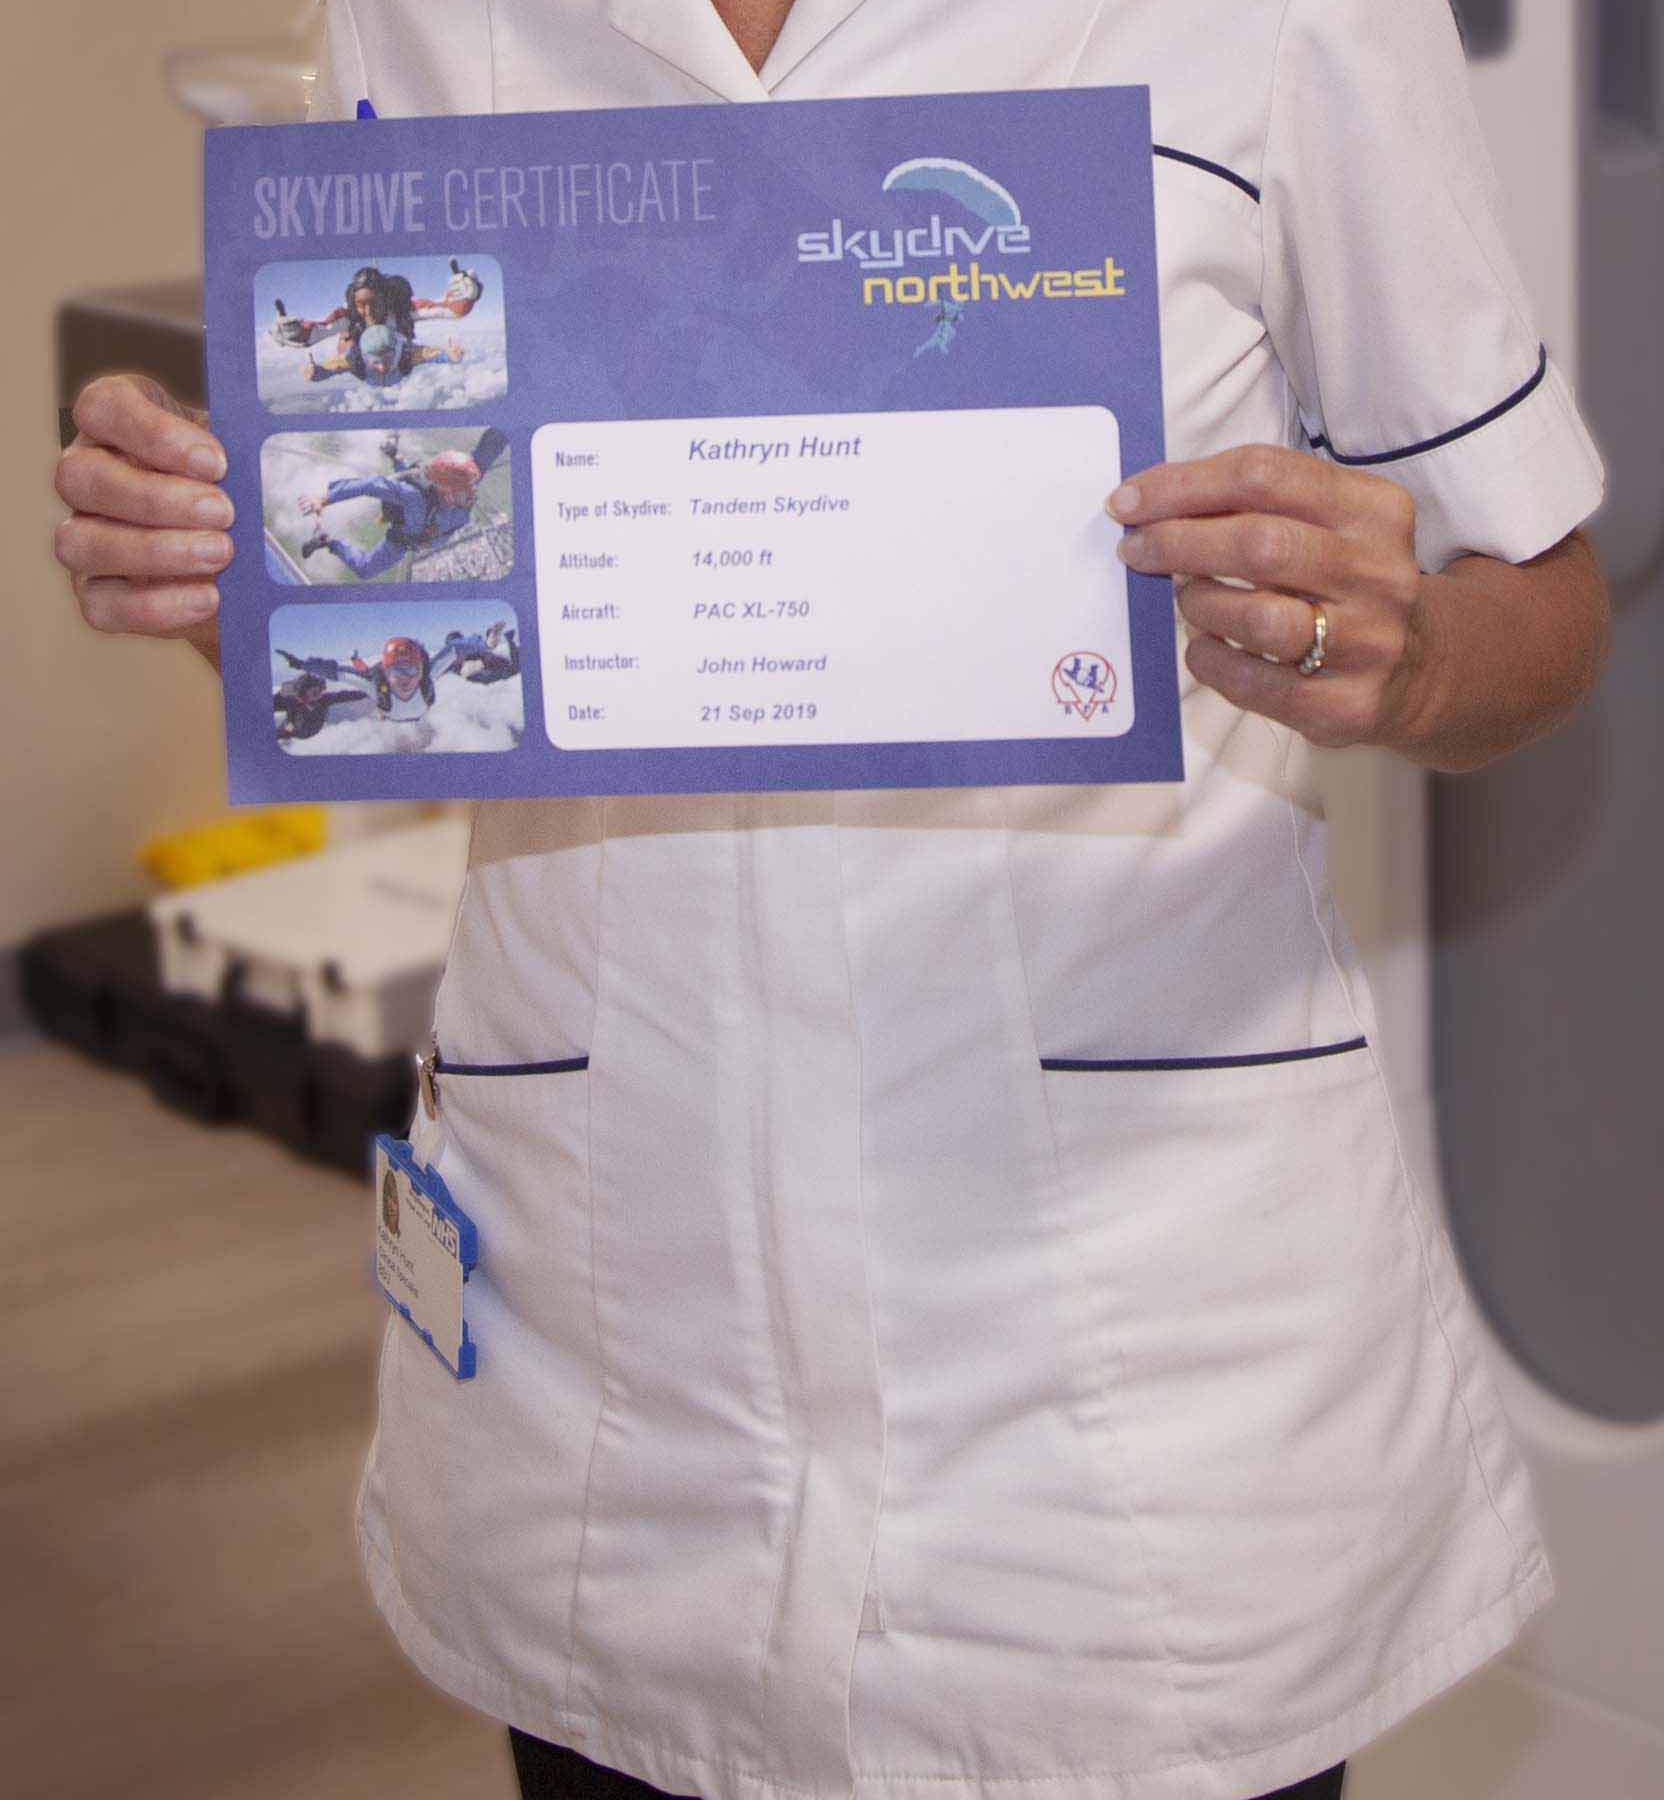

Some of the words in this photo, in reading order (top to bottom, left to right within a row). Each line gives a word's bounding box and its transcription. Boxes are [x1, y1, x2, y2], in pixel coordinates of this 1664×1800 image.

[253, 171, 426, 239] SKYDIVE
[443, 159, 717, 231] CERTIFICATE
[797, 214, 1031, 269] skydive
[863, 257, 1125, 304] northwest
[555, 451, 600, 467] Name:
[688, 438, 790, 465] Kathryn
[799, 435, 863, 458] Hunt
[558, 502, 588, 521] Type
[594, 501, 608, 517] of
[613, 499, 673, 519] Skydive:
[690, 498, 766, 516] Tandem
[773, 494, 851, 517] Skydive
[559, 552, 620, 569] Altitude:
[692, 550, 753, 570] 14,000
[758, 549, 774, 566] ft
[561, 603, 621, 620] Aircraft:
[693, 602, 736, 619] PAC
[742, 600, 810, 618] XL-750
[564, 654, 640, 671] Instructor:
[697, 656, 745, 674] John
[751, 655, 828, 673] Howard
[567, 705, 605, 721] Date:
[701, 705, 721, 722] 21
[728, 705, 765, 724] Sep
[772, 703, 818, 720] 2019
[433, 1208, 458, 1258] NHS
